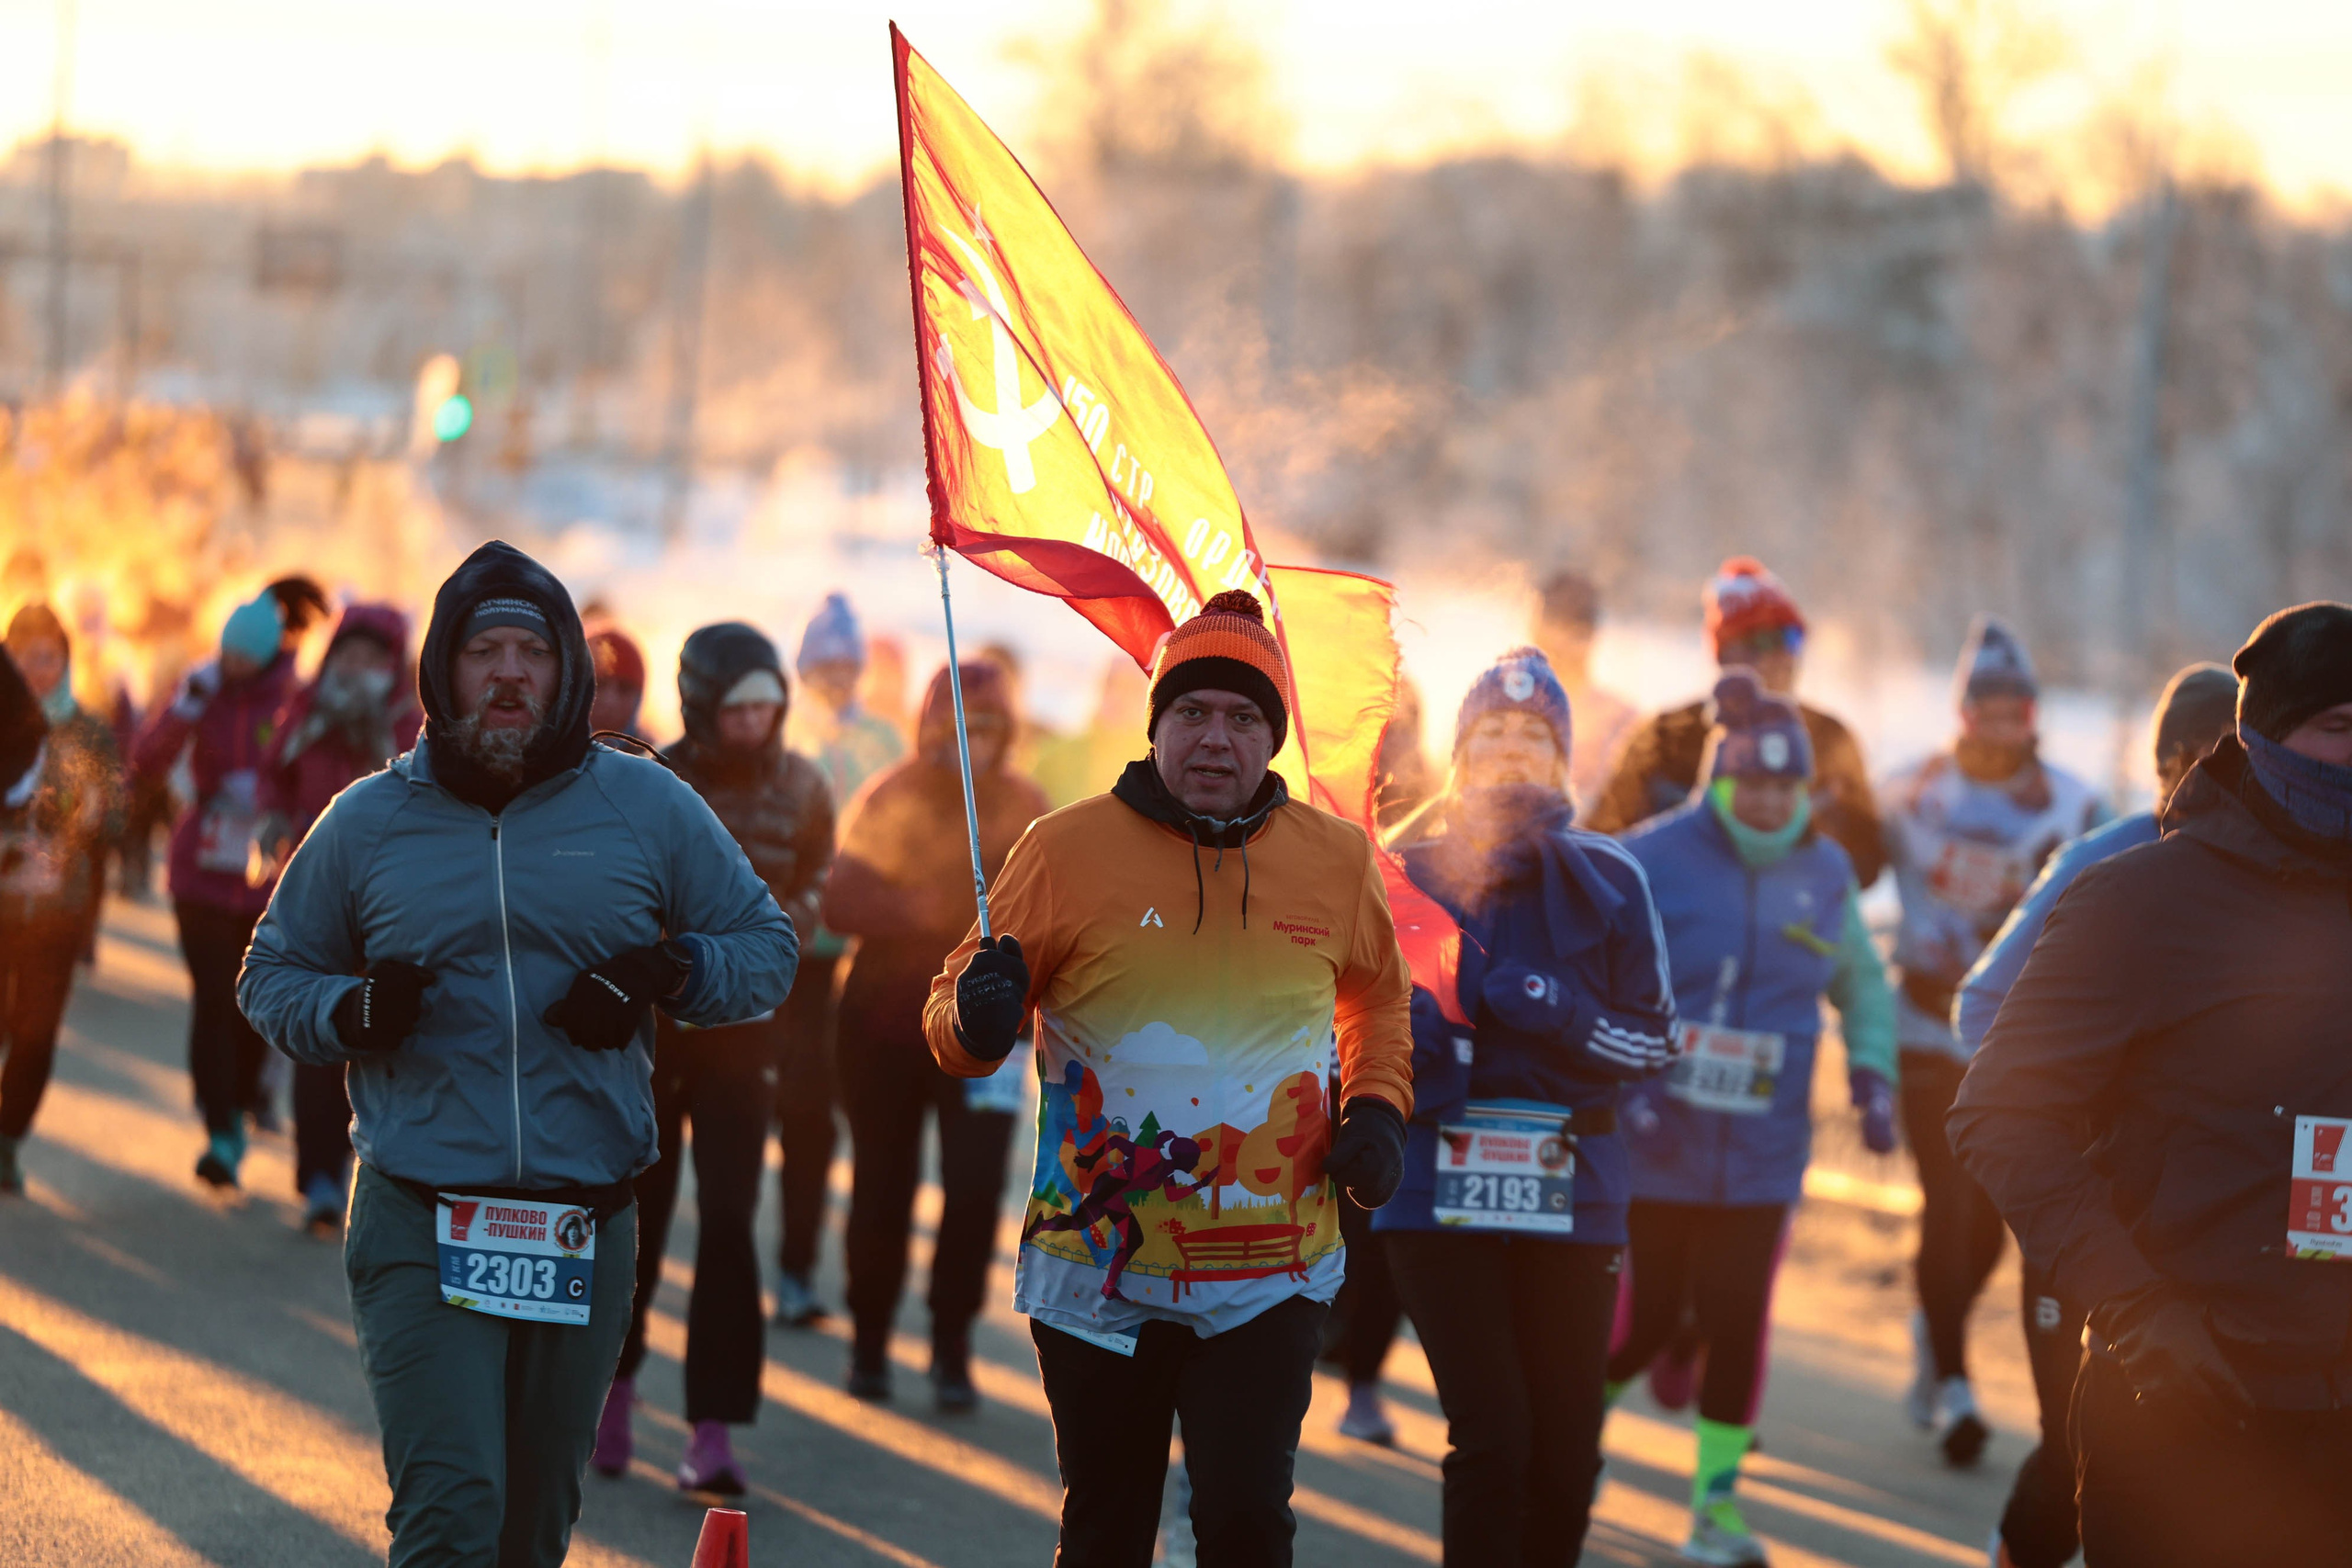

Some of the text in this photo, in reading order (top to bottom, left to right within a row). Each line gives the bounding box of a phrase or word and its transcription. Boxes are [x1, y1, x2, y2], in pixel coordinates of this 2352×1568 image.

[1273, 920, 1330, 937] Муринский
[1291, 935, 1317, 947] парк
[363, 984, 372, 1029] MADSHUS
[1463, 1174, 1542, 1212] 2193
[485, 1205, 548, 1225] ПУЛКОВО
[483, 1223, 547, 1242] -ПУШКИН
[467, 1252, 558, 1300] 2303
